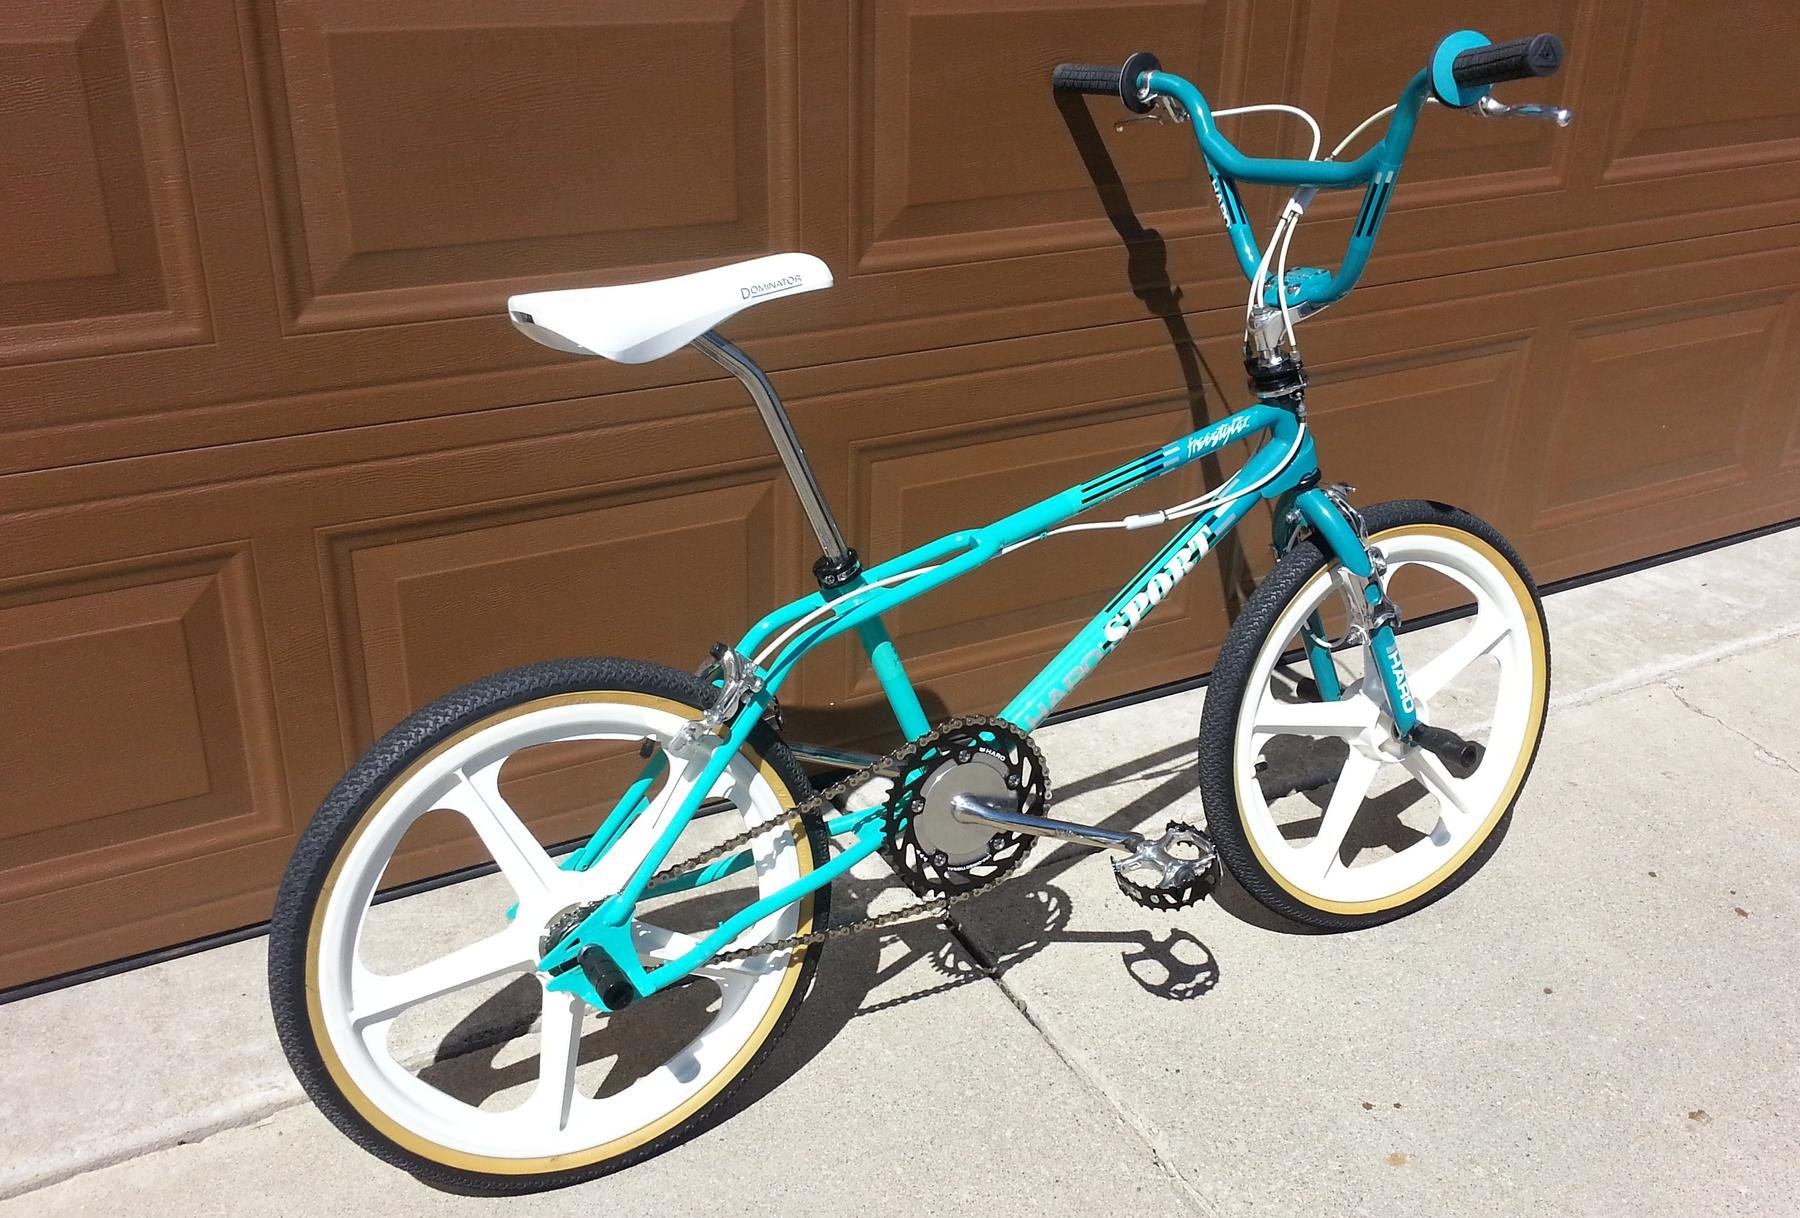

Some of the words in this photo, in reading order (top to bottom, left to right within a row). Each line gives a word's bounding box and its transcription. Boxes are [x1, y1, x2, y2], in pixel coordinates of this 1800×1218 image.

[741, 275, 802, 299] DOMINATOR
[1026, 647, 1106, 729] HARO
[1104, 524, 1212, 641] SPORT
[1387, 650, 1414, 713] HARO
[985, 748, 1006, 762] HARO
